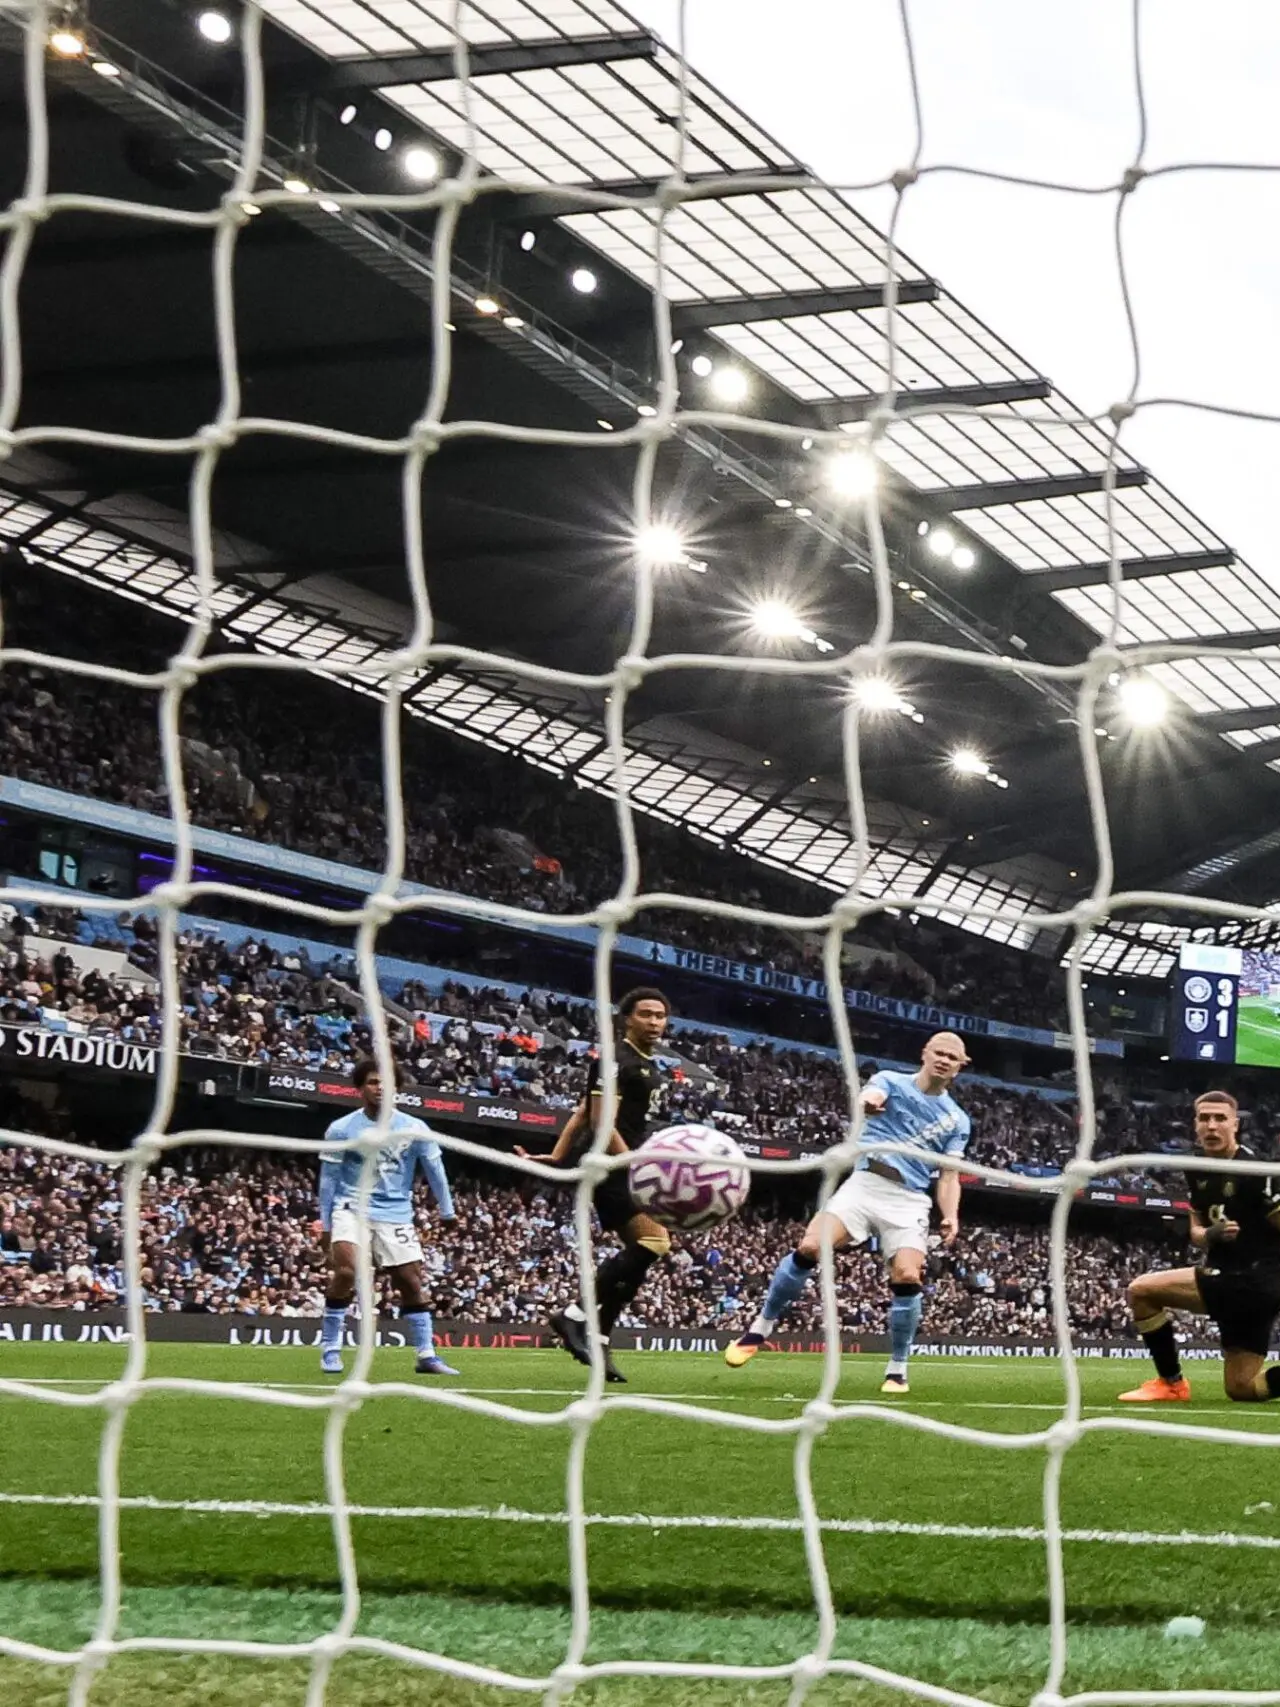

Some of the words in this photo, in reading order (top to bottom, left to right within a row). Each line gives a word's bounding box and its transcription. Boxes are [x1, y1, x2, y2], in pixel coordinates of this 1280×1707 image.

[760, 966, 811, 996] ONLY
[815, 980, 855, 1007] OE
[916, 1002, 989, 1033] HATTON
[1216, 978, 1233, 1007] 3
[1215, 1009, 1228, 1037] 1
[16, 1029, 155, 1074] STADIUM
